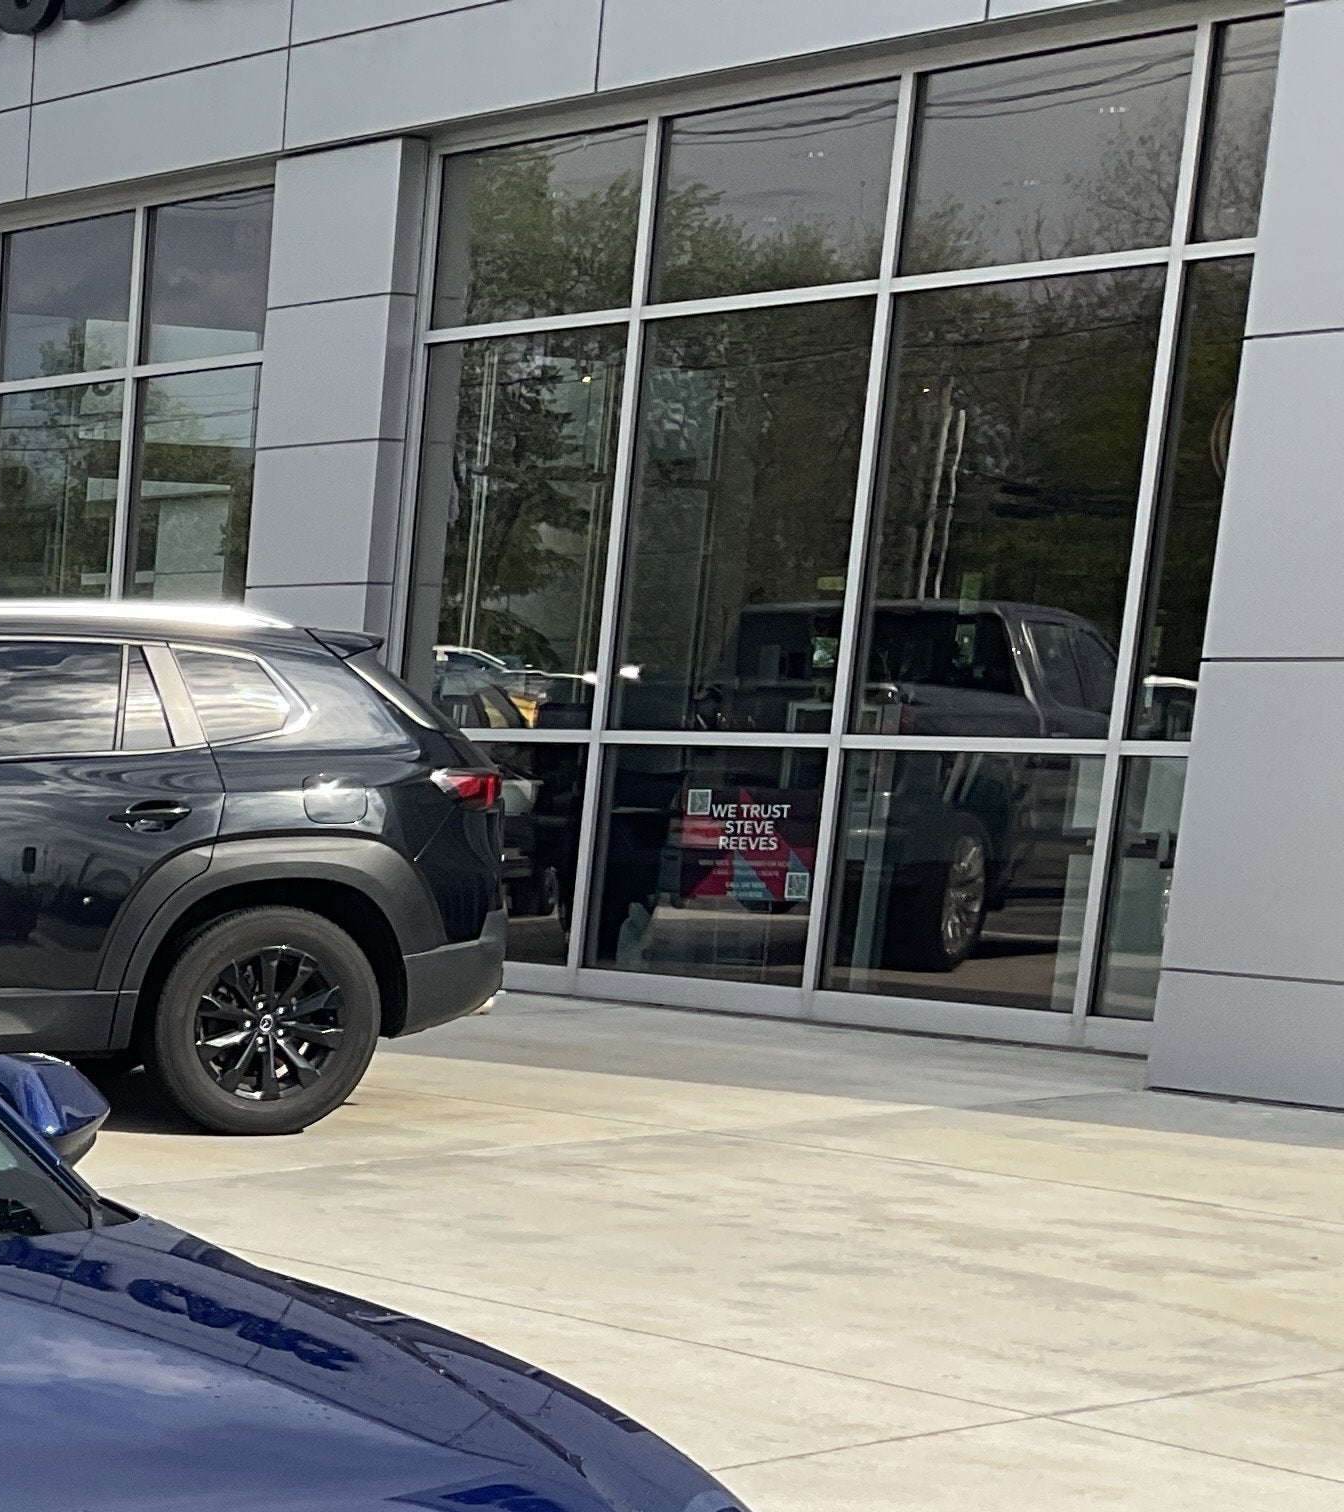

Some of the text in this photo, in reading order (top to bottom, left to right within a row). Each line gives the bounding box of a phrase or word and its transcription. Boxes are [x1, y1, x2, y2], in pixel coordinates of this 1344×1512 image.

[712, 804, 791, 819] WE TRUST
[725, 820, 774, 835] STEVE
[718, 836, 779, 850] REEVES
